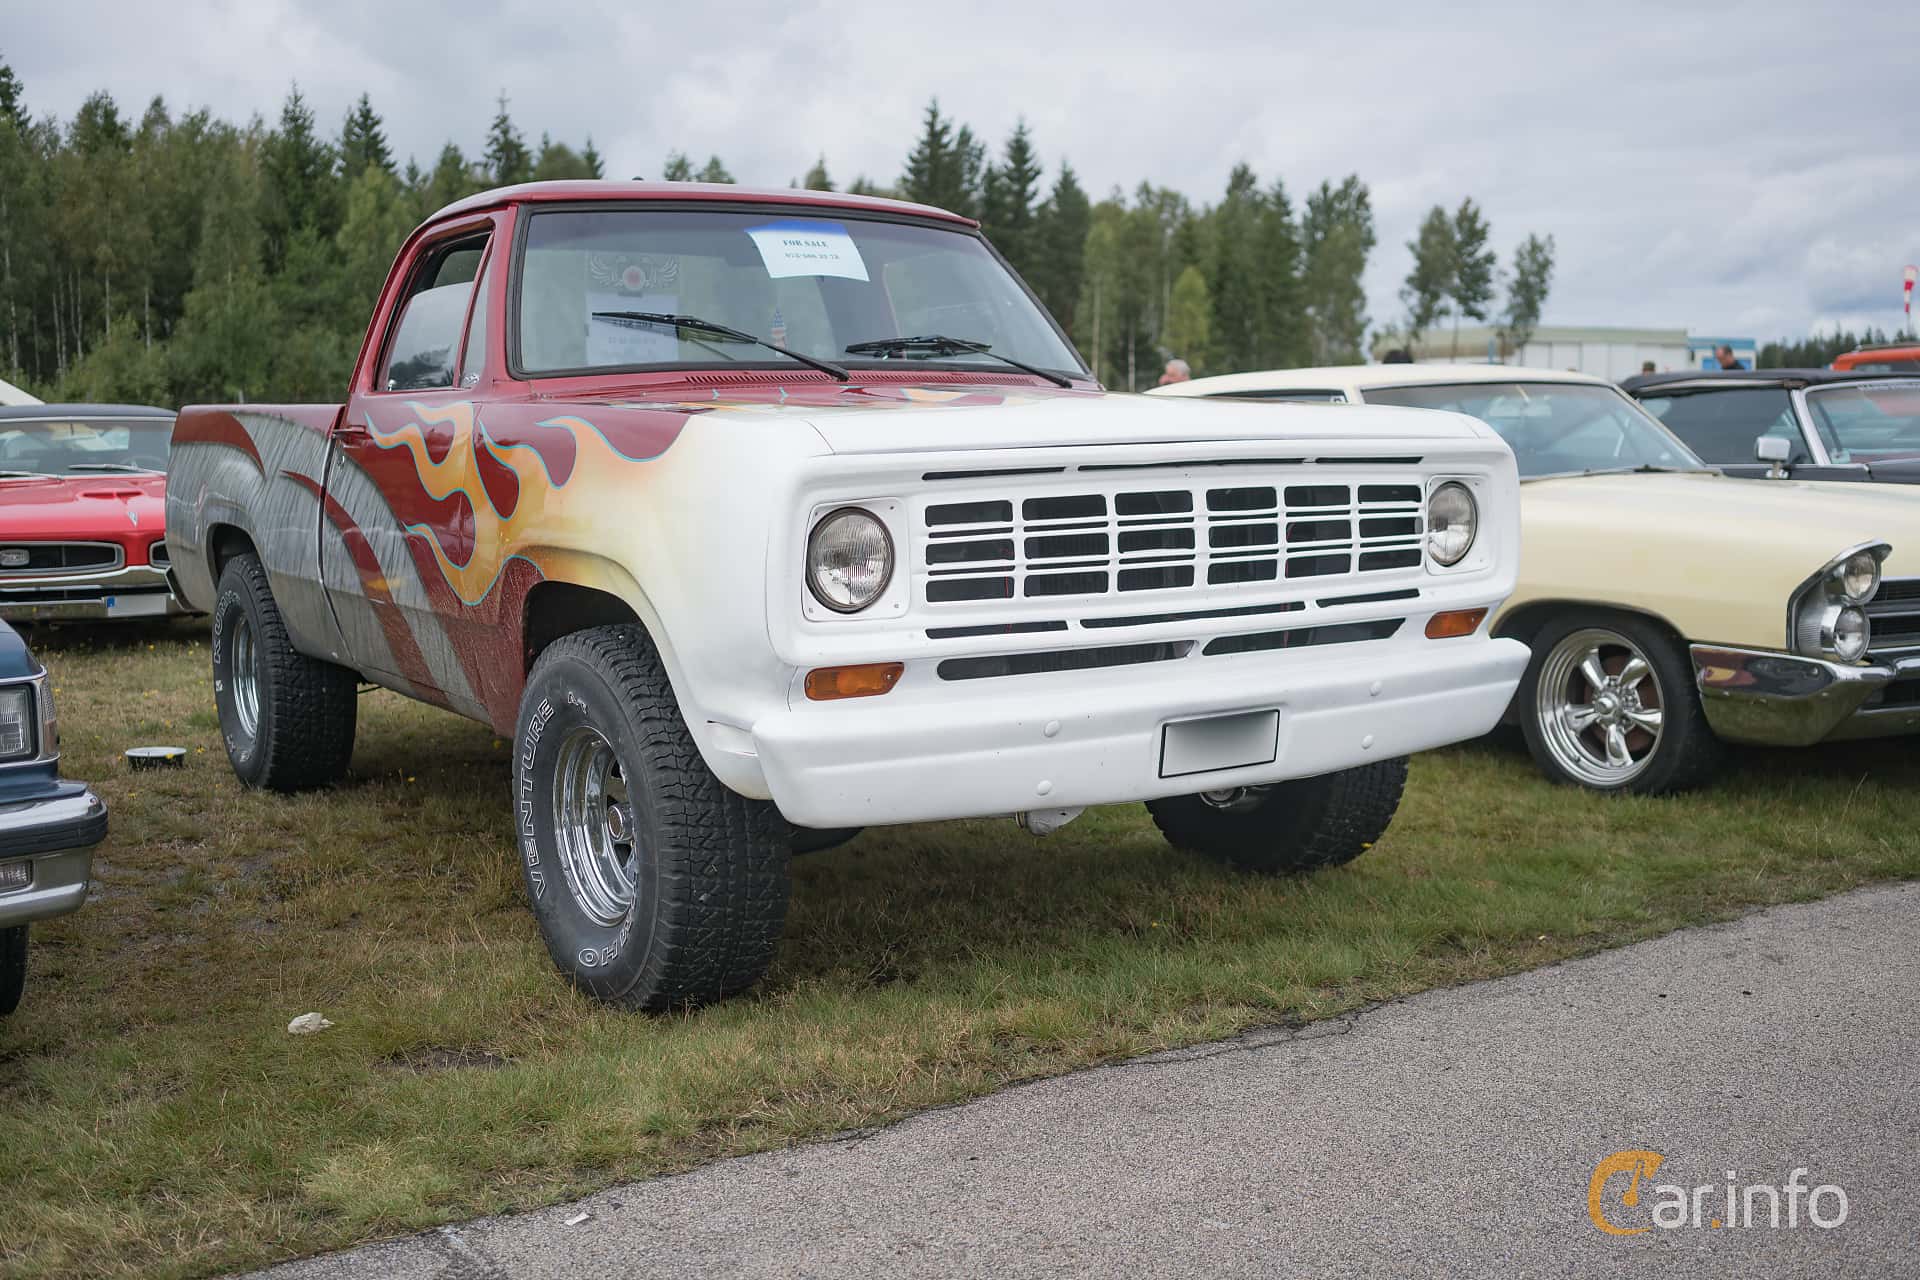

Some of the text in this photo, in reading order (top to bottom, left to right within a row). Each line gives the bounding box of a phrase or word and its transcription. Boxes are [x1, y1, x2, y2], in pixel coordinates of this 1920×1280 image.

[783, 239, 828, 248] FOR SALE
[520, 698, 554, 899] VENTURE
